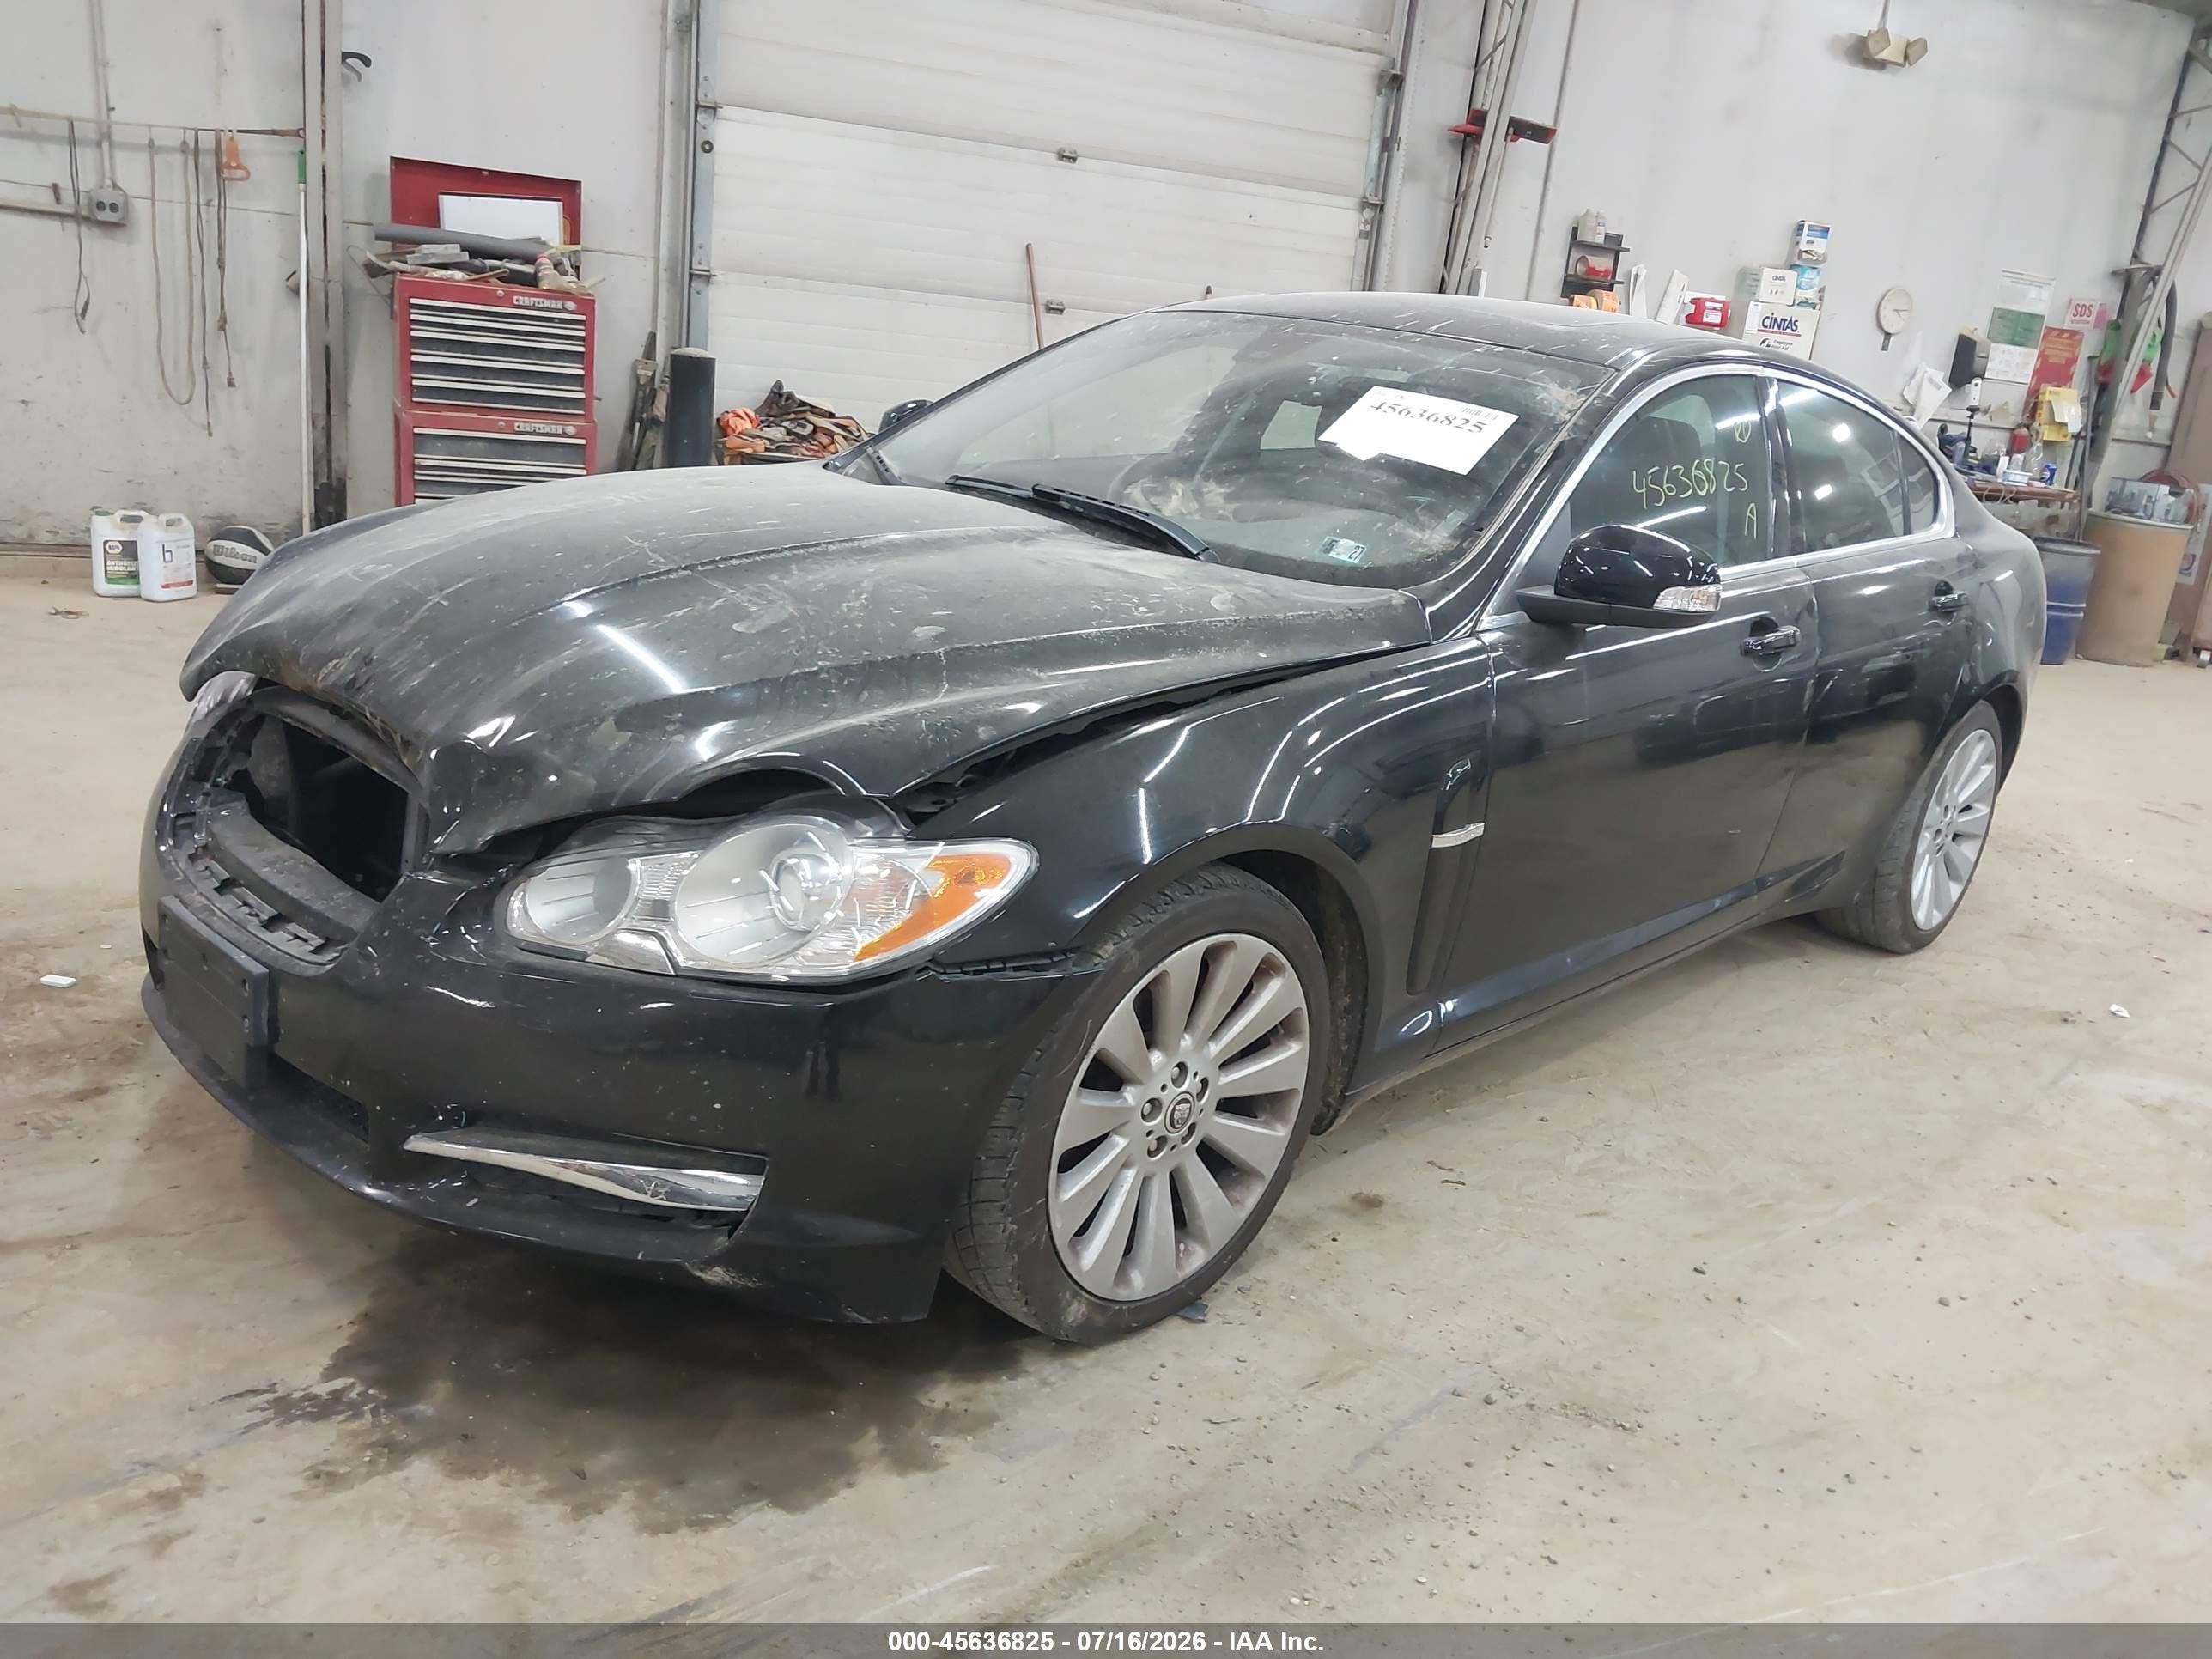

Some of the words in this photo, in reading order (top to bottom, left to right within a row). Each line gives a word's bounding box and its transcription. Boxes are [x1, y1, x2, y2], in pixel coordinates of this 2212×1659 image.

[513, 295, 562, 309] CRAFTSMAN
[2072, 302, 2094, 318] SDS
[1370, 401, 1487, 434] 45636825
[514, 422, 563, 434] CRAFTSMAN
[1632, 459, 1748, 509] 45636825
[1744, 502, 1757, 539] A
[212, 544, 257, 564] Wilson
